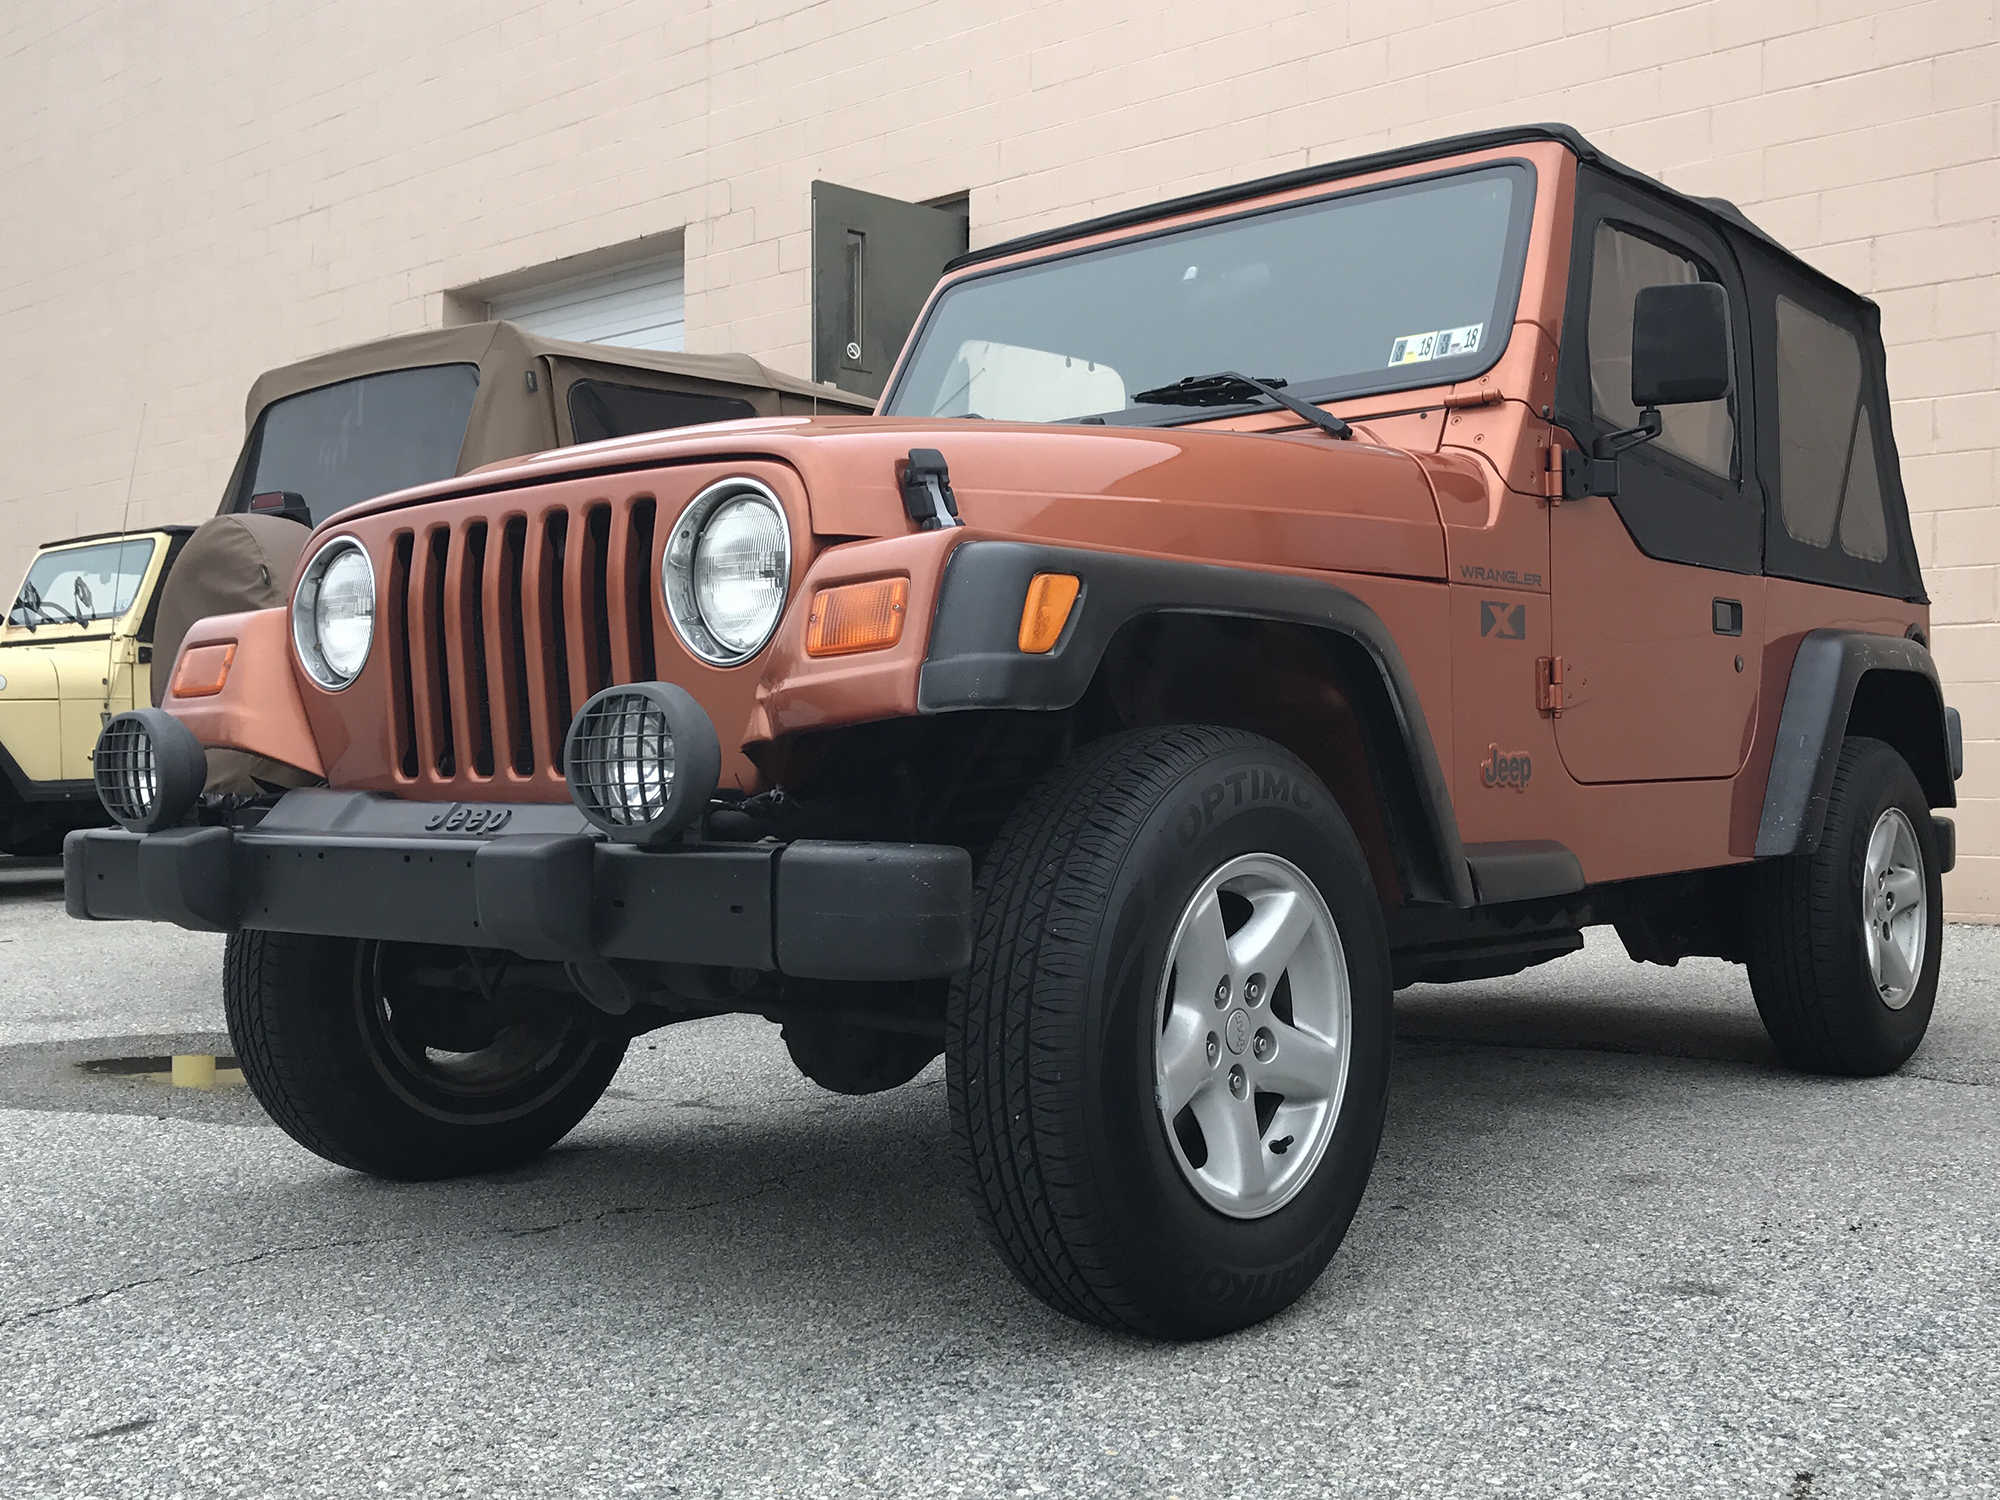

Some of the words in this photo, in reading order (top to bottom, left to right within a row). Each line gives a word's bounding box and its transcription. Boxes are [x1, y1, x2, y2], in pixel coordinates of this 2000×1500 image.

[1418, 336, 1433, 356] 18
[1463, 327, 1479, 348] 18
[1459, 565, 1542, 586] WRANGLER
[1482, 601, 1525, 640] X
[1481, 744, 1531, 791] Jeep
[425, 802, 512, 836] Jeep
